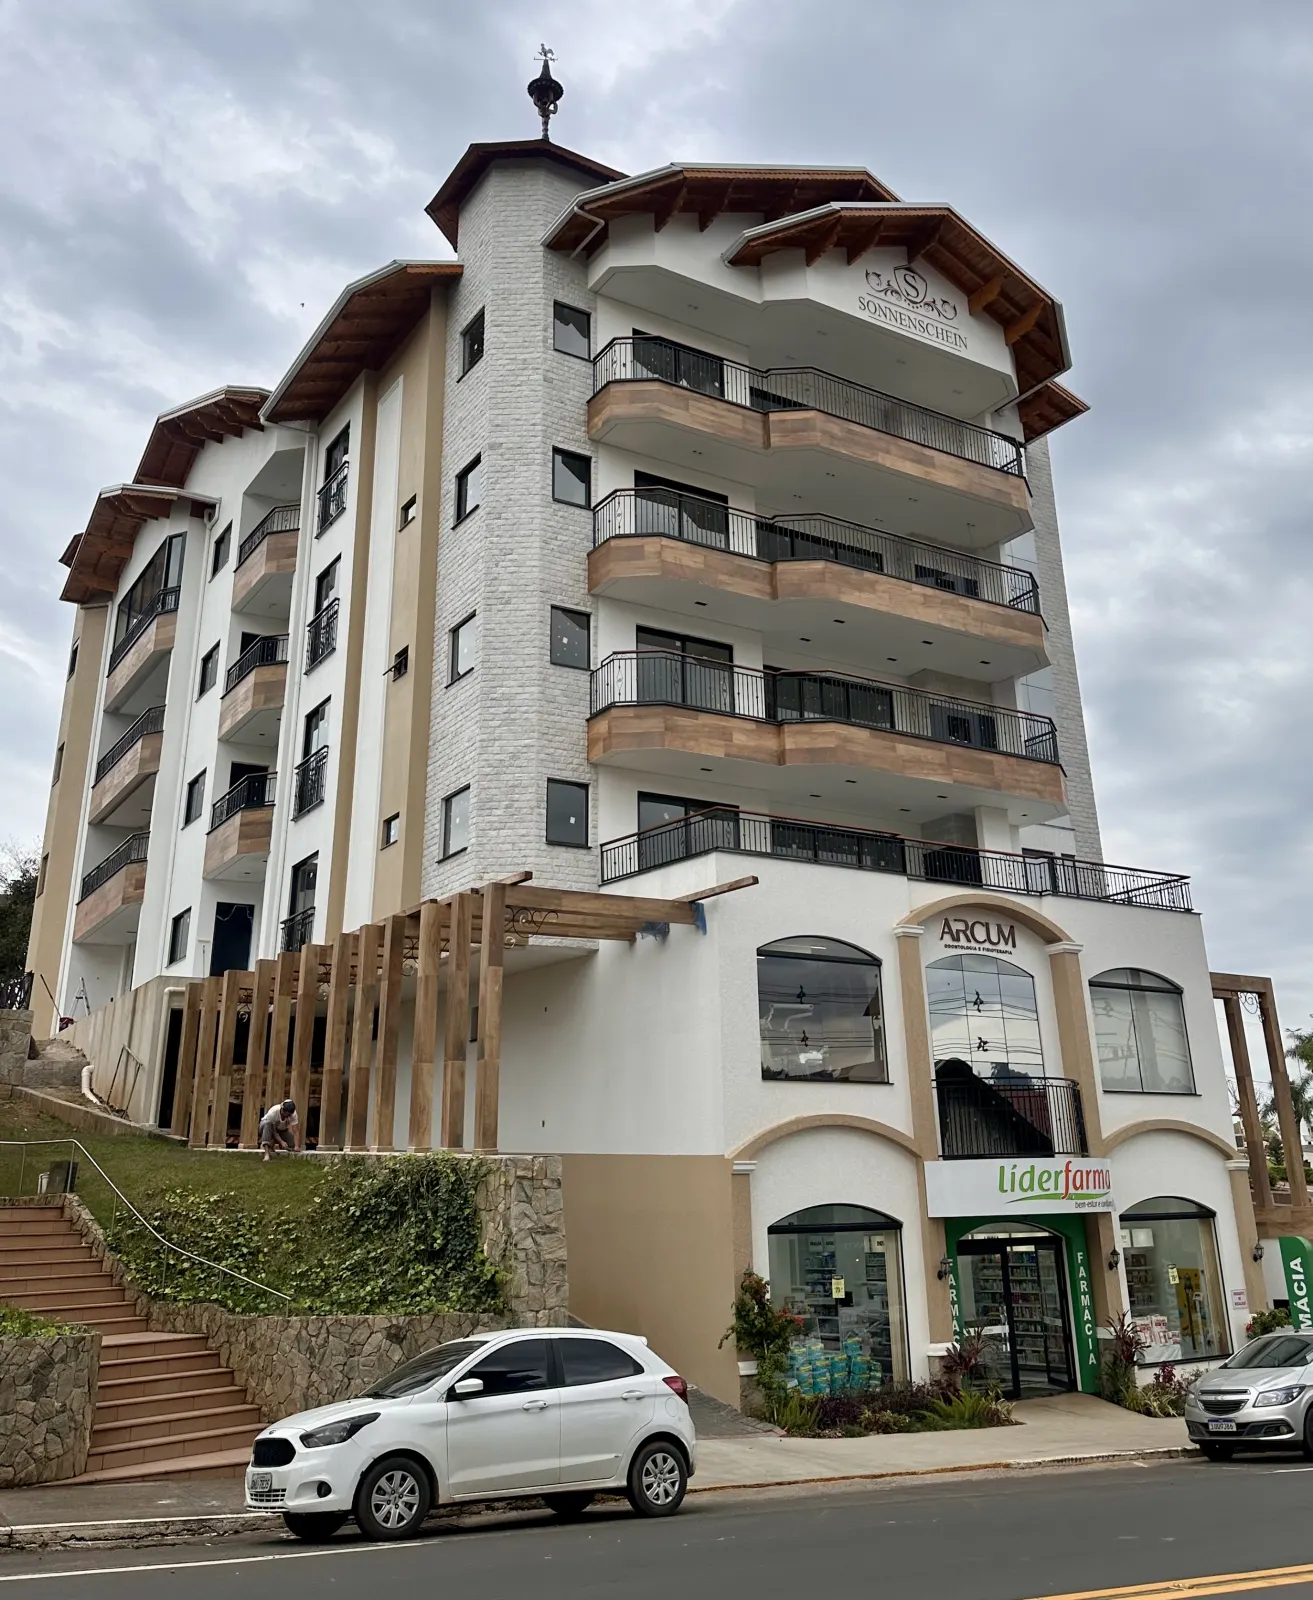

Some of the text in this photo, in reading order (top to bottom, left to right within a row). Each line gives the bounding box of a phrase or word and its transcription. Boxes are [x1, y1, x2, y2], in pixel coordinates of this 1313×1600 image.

[903, 273, 920, 299] S
[858, 295, 968, 350] SONNENSCHEIN
[940, 917, 1017, 949] ARCUM
[944, 943, 977, 951] ODONTOLOGIA
[982, 946, 1013, 955] FISIOTERAPIA
[1077, 1251, 1097, 1365] FARMÁCIA
[1289, 1256, 1313, 1330] MÁCIA
